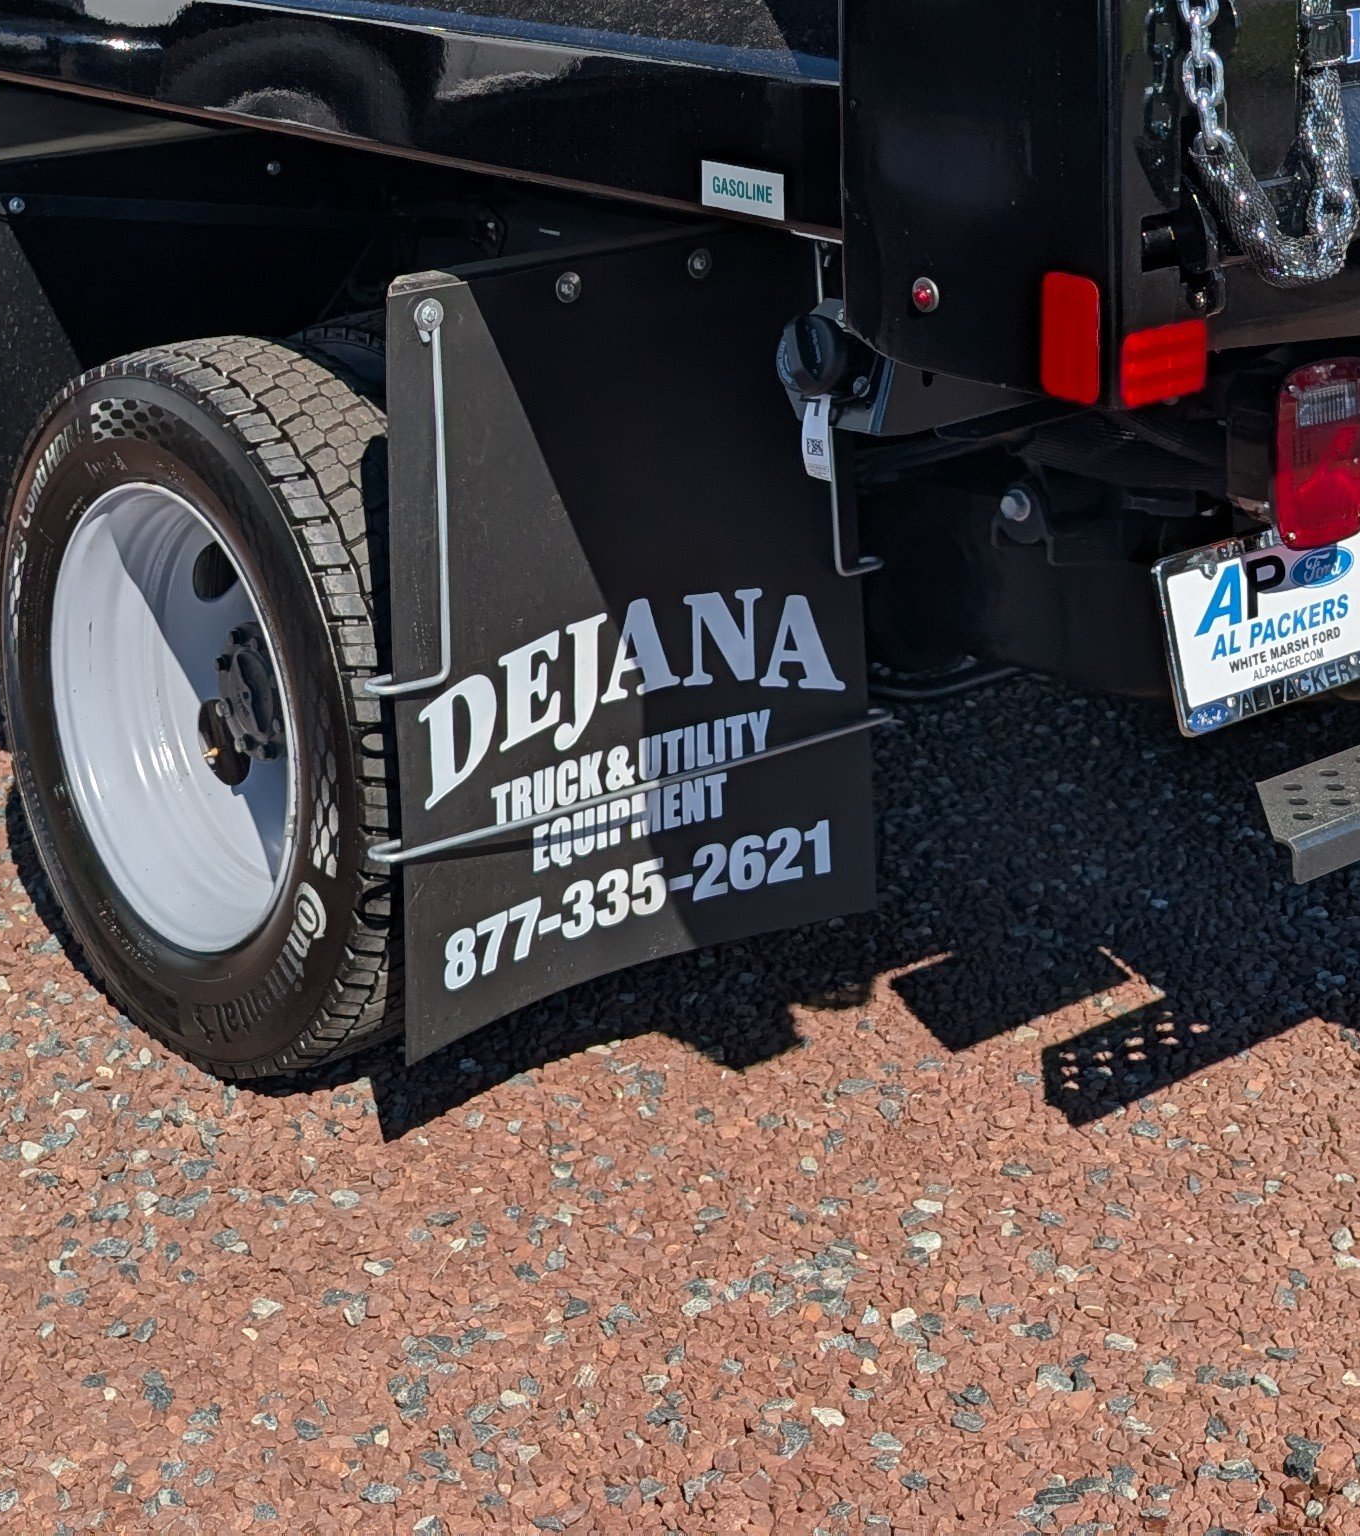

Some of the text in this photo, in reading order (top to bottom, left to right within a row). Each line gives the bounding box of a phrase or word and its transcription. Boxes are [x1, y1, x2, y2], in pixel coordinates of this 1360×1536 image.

[712, 176, 773, 204] GASOLINE
[1211, 593, 1349, 662] AL PACKERS
[1229, 626, 1341, 673] WHITE MARSH FORD
[1253, 648, 1324, 682] ALPACKER.COM
[418, 587, 846, 811] DEJANA
[490, 749, 604, 826] TRUCK
[637, 708, 772, 781] UTILITY
[532, 772, 728, 873] EQUIPMENT
[444, 819, 832, 992] 877-335-2621
